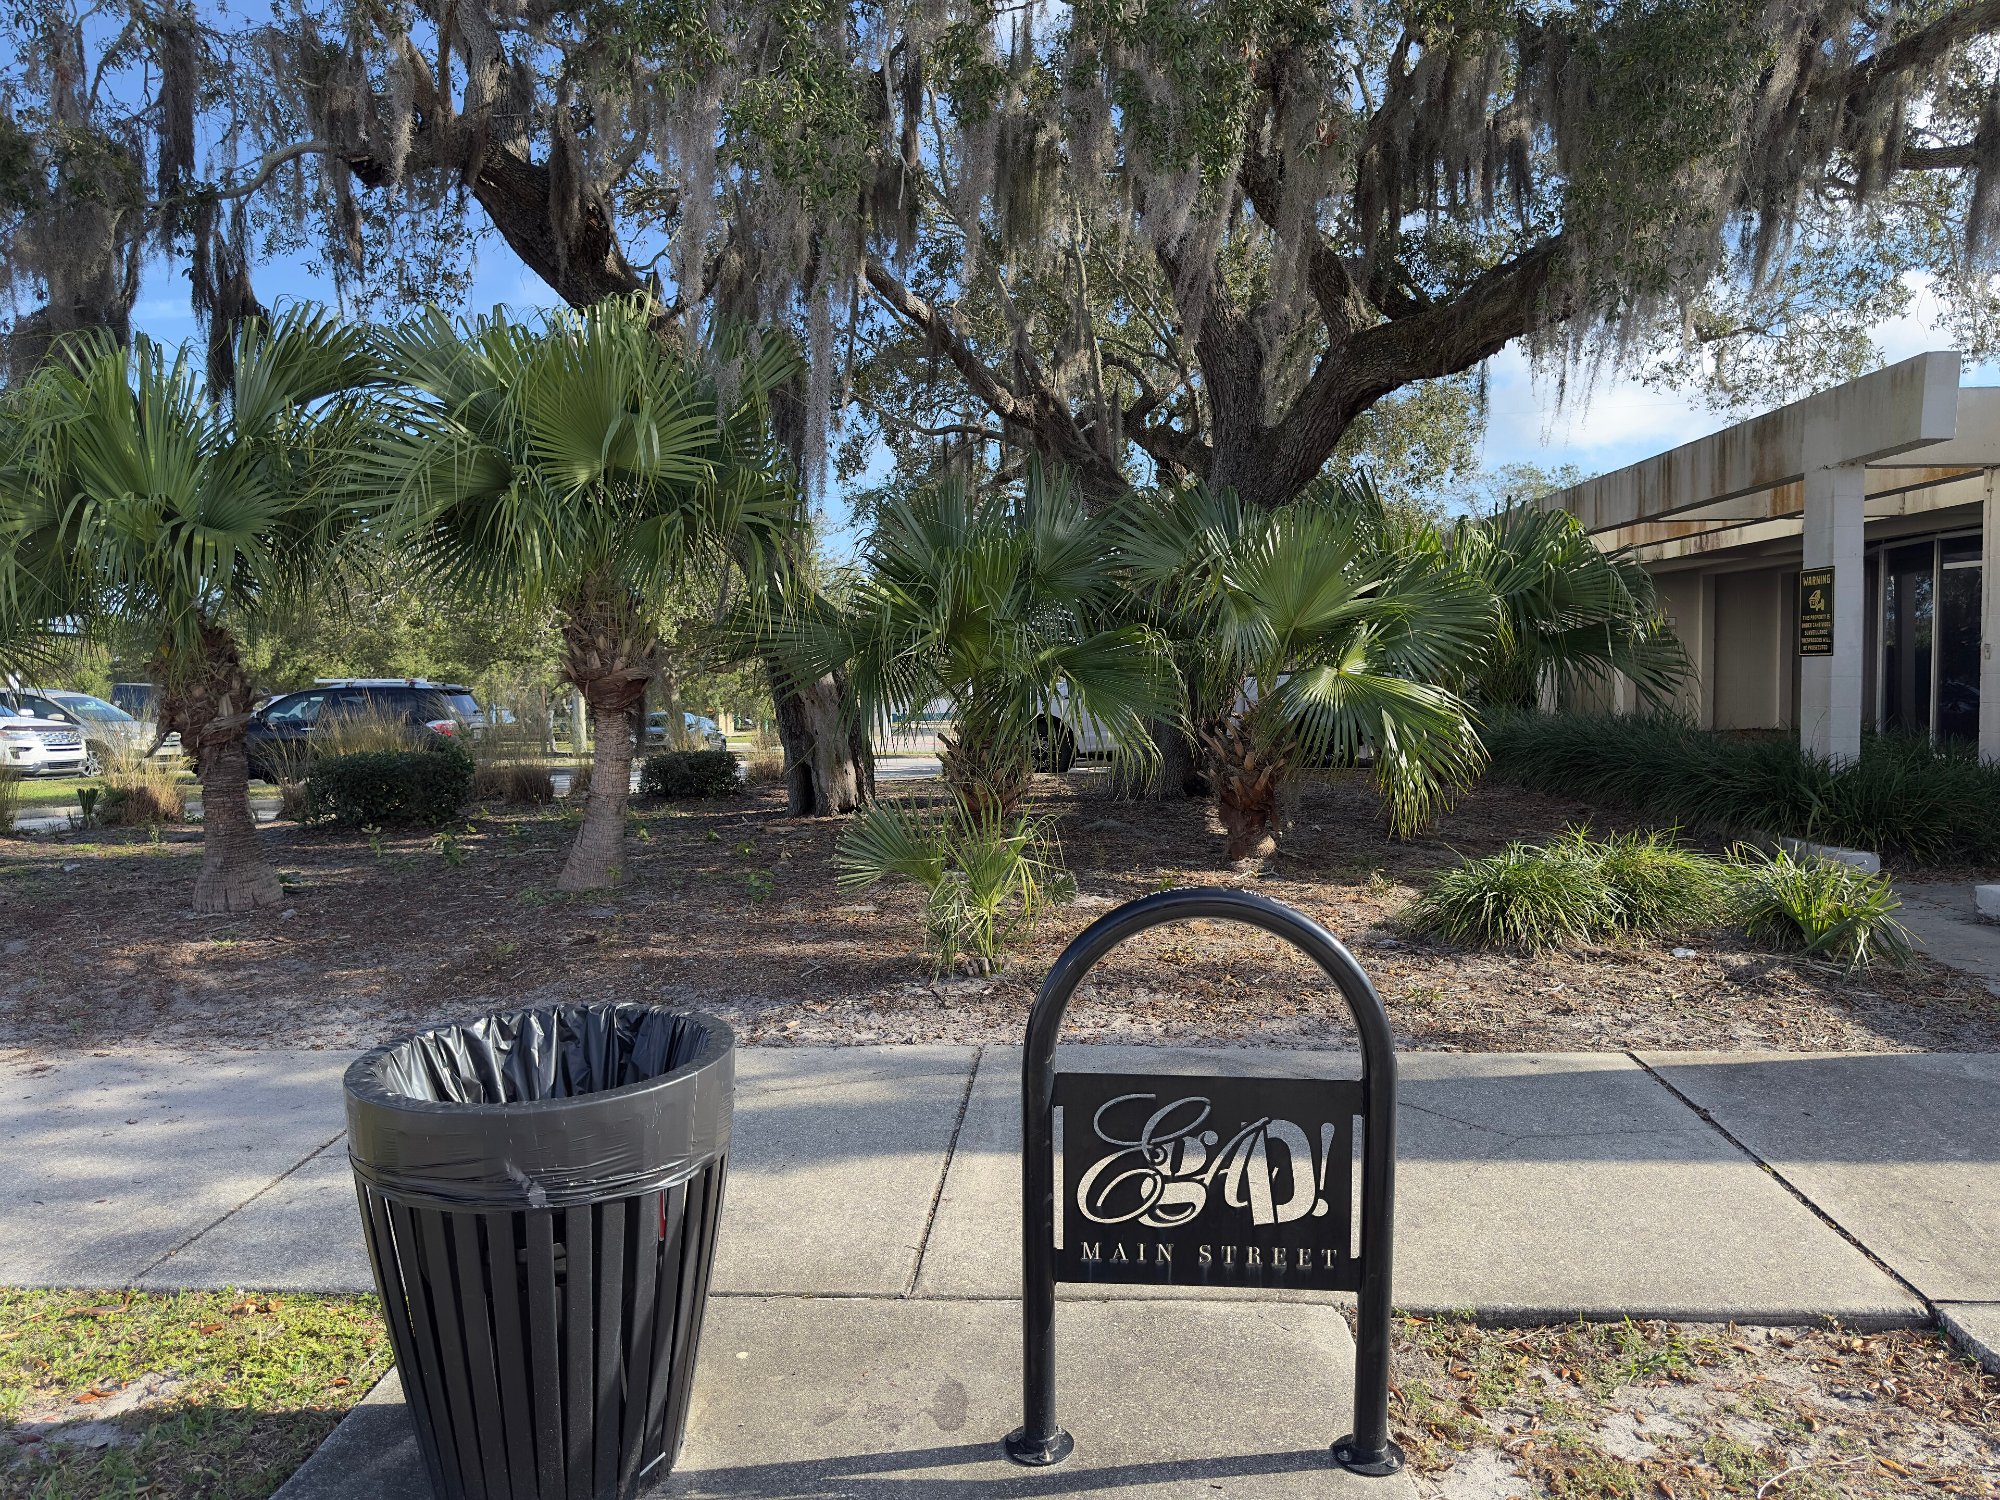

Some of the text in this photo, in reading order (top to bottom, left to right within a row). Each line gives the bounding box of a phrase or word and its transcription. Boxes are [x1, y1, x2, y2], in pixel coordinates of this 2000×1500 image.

[1802, 574, 1831, 587] WARNING
[1081, 1241, 1337, 1270] MAIN STREET
